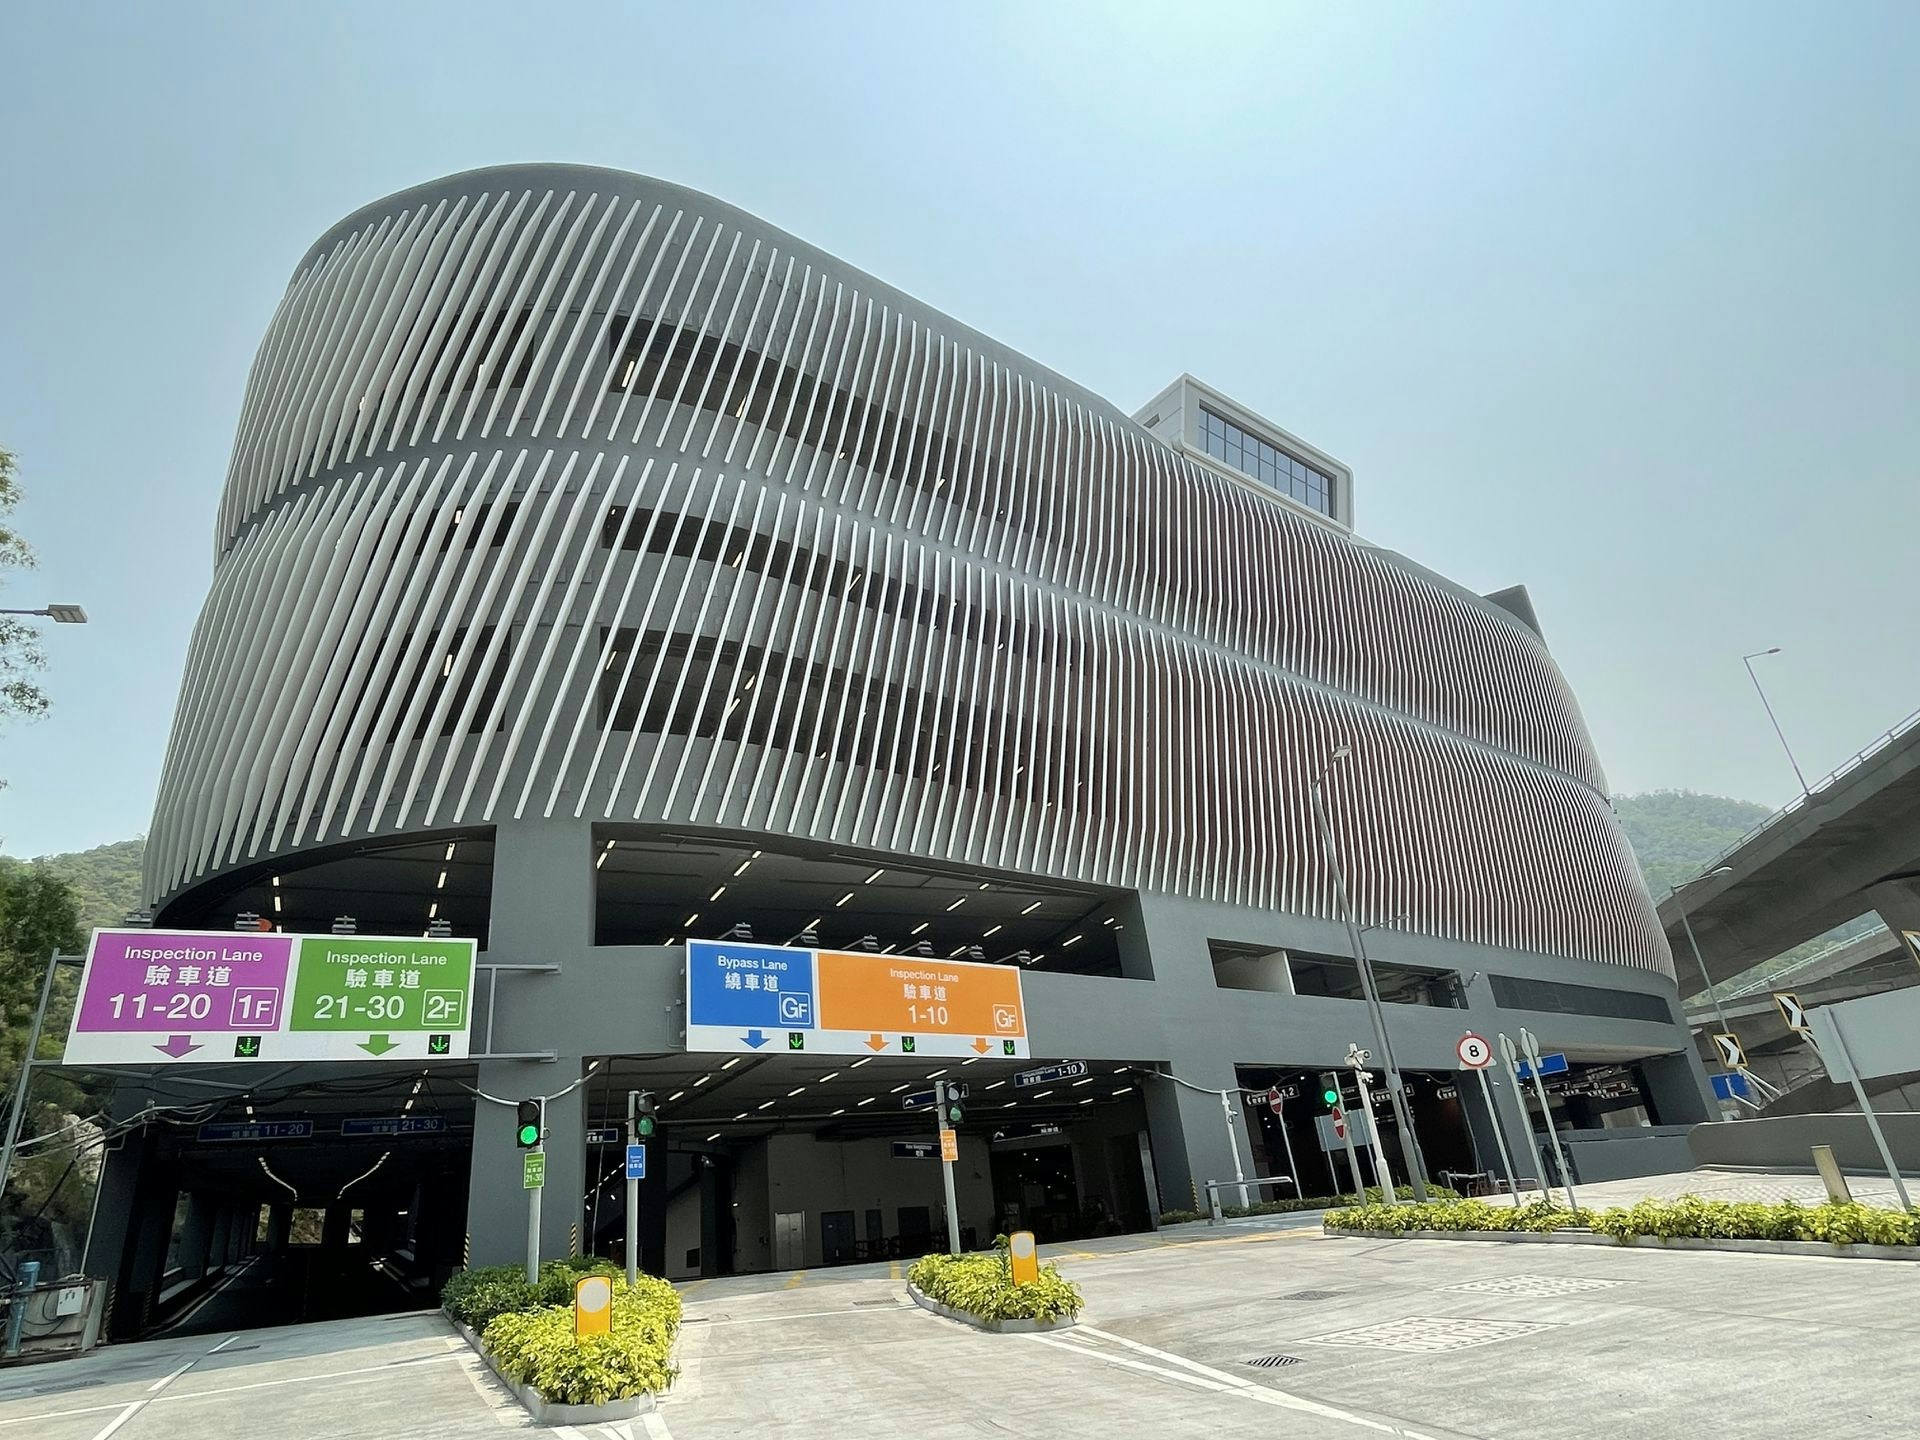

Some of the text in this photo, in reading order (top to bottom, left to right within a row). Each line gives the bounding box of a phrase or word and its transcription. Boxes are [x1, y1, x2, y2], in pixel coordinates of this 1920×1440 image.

[124, 945, 263, 963] Inspection Lane
[326, 950, 448, 967] Inspection Lane
[717, 954, 788, 971] Bypass Lane
[143, 965, 232, 987] 驗車道
[344, 968, 421, 989] 驗車道
[725, 972, 780, 993] 繞車道
[889, 967, 959, 983] Inspection Lane
[903, 983, 948, 1002] 驗車道
[109, 993, 211, 1020] 11-20
[238, 995, 273, 1020] 1F
[313, 995, 405, 1020] 21-30
[426, 996, 459, 1019] 2F
[781, 997, 809, 1019] GF
[908, 1005, 949, 1025] 1-10
[995, 1008, 1017, 1028] GF
[1468, 1045, 1480, 1058] 8
[1058, 1065, 1078, 1077] 1-10
[264, 1123, 304, 1136] 11-20
[401, 1119, 438, 1131] 21-30
